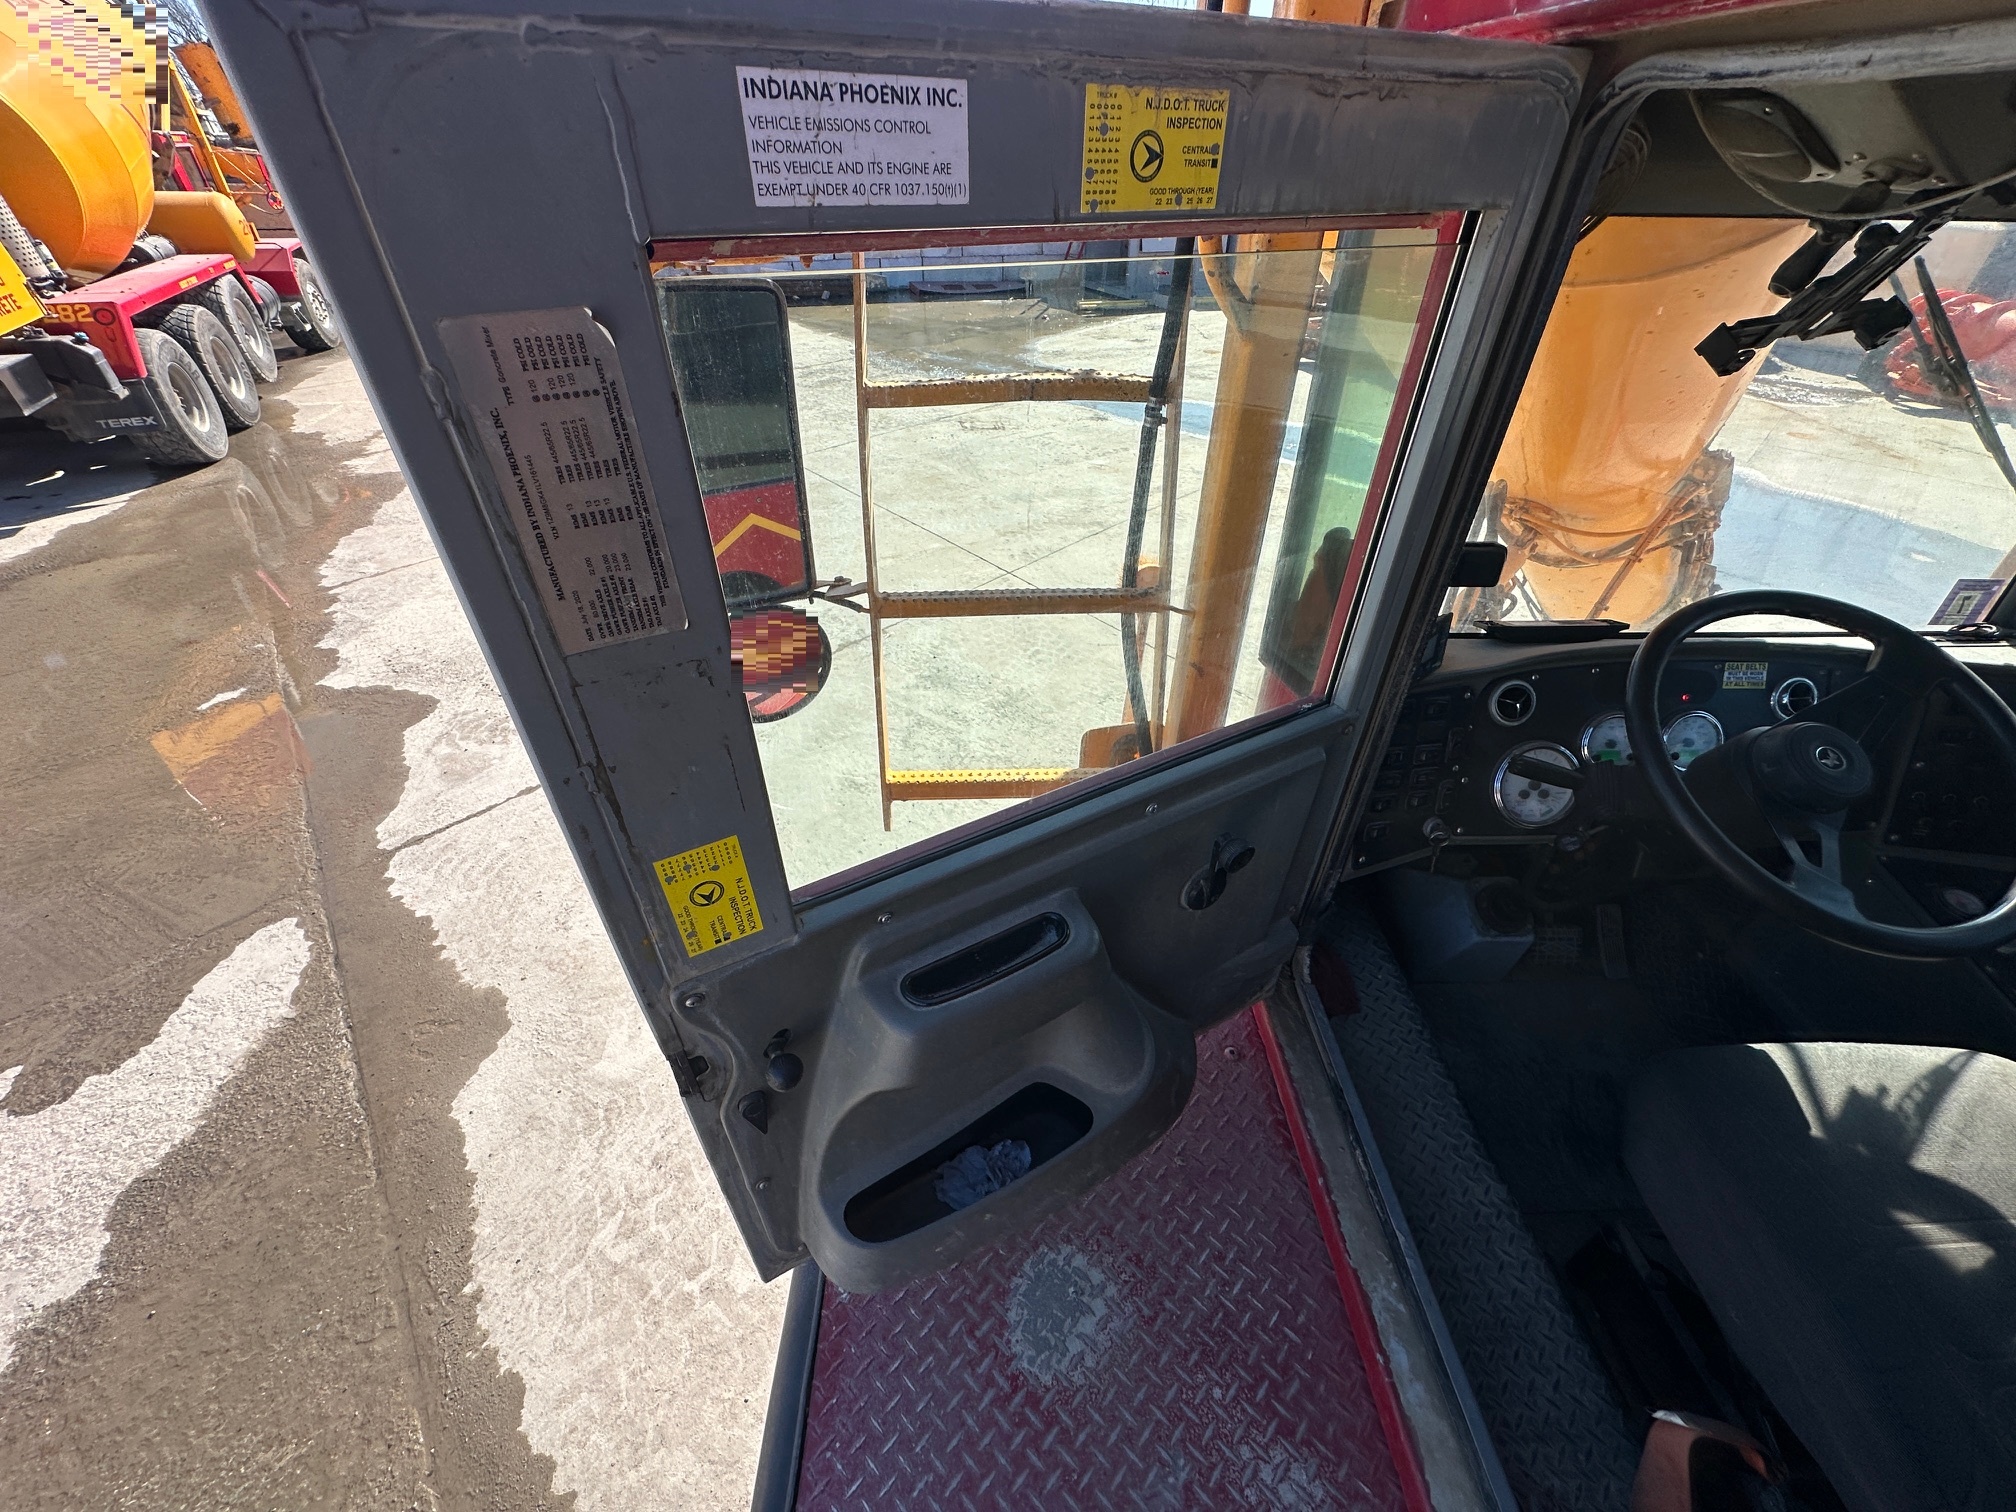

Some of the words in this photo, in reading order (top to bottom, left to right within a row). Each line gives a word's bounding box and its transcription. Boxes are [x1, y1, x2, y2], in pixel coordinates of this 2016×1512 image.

[742, 77, 834, 102] INDIANA
[840, 83, 921, 106] PHOENIX
[926, 88, 962, 108] INC.
[1146, 97, 1190, 111] N.J.D.O.T.
[1193, 99, 1226, 112] TRUCK
[748, 116, 802, 131] VEHICLE
[805, 117, 871, 133] EMISSIONS
[874, 120, 931, 135] CONTROL
[1166, 117, 1223, 130] INSPECTION
[751, 139, 843, 154] INFORMATION
[1182, 145, 1212, 155] CENTRAL
[753, 161, 781, 174] THIS
[784, 161, 834, 175] VEHICLE
[837, 162, 864, 175] AND
[867, 162, 883, 175] ITS
[887, 162, 929, 175] ENGINE
[932, 163, 952, 175] ARE
[1184, 158, 1212, 168] TRANSIT
[758, 183, 802, 196] EXEMPT
[807, 183, 849, 196] UNDER
[852, 184, 866, 195] 40
[869, 183, 891, 196] CFR
[1167, 187, 1195, 195] THROUGH
[1196, 187, 1215, 195] (YEAR)
[479, 325, 494, 347] Mixer
[533, 335, 546, 356] COLD
[544, 334, 556, 355] COLD
[555, 334, 567, 355] COLD
[565, 333, 577, 354] COLD
[575, 332, 587, 353] COLD
[512, 337, 525, 359] COLD
[523, 336, 536, 358] COLD
[501, 386, 515, 405] TYPE
[95, 415, 159, 429] TEREX
[488, 406, 504, 429] INC.
[496, 430, 522, 476] PHOENIX,
[554, 465, 566, 484] TIRES
[564, 464, 575, 483] TIRES
[573, 462, 584, 481] TIRES
[583, 461, 594, 480] TIRES
[592, 459, 603, 478] TIRES
[602, 458, 612, 477] TIRES
[611, 457, 621, 476] TIRES
[514, 477, 536, 517] INDIANA
[529, 518, 540, 530] BY
[638, 520, 646, 530] ALL
[533, 531, 566, 601] MANUFACTURED
[584, 627, 594, 641] DATE
[1726, 663, 1744, 671] SEAT
[716, 914, 727, 933] CENTRA
[728, 895, 747, 935] INSPECTION
[744, 907, 757, 931] TRUCK
